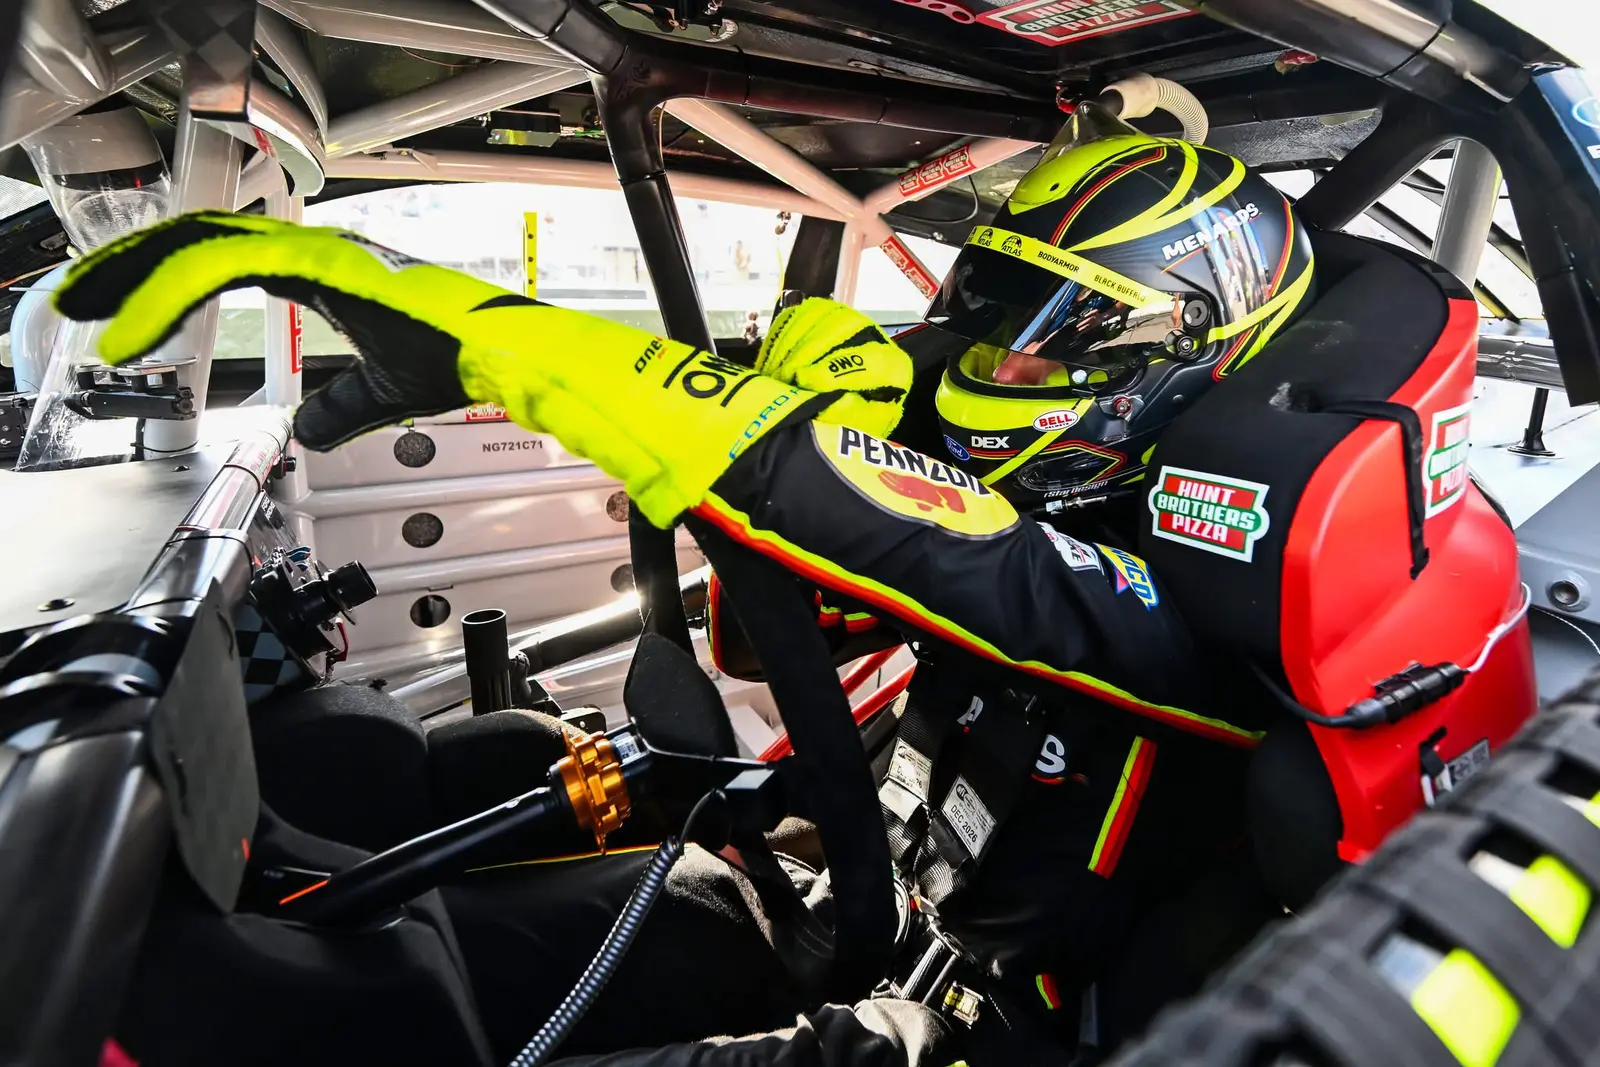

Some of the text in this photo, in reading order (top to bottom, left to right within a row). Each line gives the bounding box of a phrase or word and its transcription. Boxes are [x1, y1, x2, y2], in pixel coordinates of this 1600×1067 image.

[1060, 8, 1146, 31] PIZZA
[1001, 245, 1023, 257] ATLAS
[1037, 251, 1080, 273] BODYARMOR
[1094, 274, 1117, 290] BLACK
[828, 354, 864, 373] OMP
[1039, 413, 1073, 427] BELL
[482, 439, 543, 453] NG721C71
[971, 435, 1011, 449] DEX
[1177, 479, 1236, 506] HUNT
[1157, 493, 1256, 531] BROTHERS
[1171, 513, 1229, 543] PIZZA
[950, 804, 978, 843] DEC 2026
